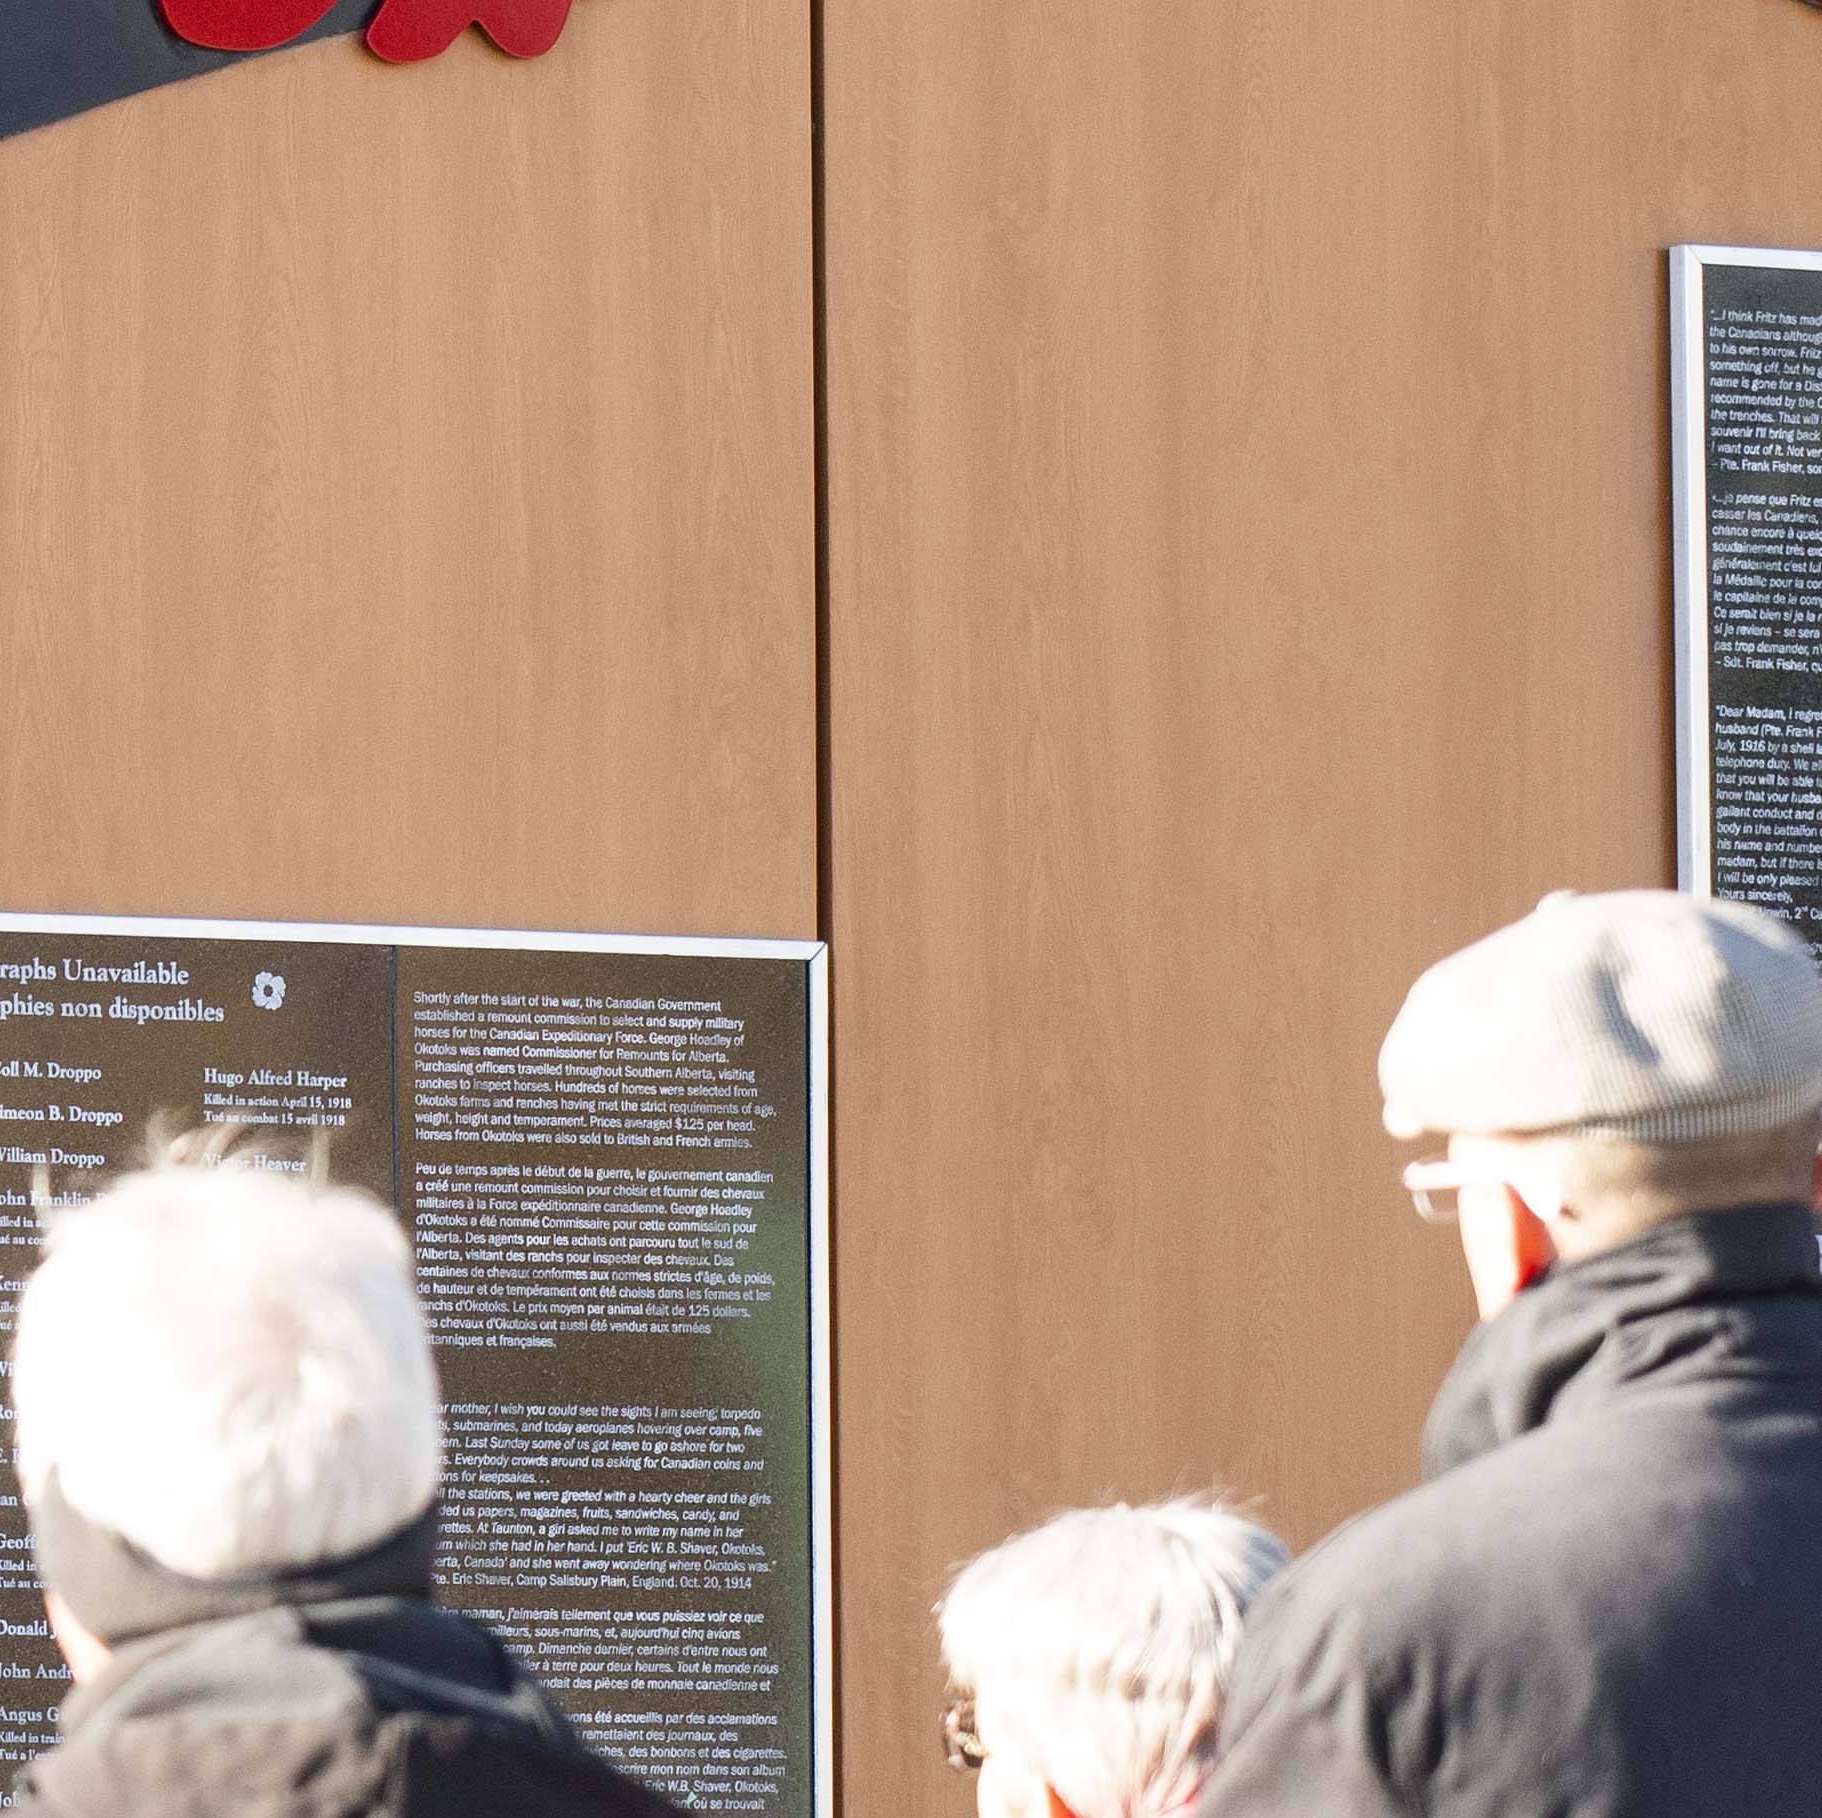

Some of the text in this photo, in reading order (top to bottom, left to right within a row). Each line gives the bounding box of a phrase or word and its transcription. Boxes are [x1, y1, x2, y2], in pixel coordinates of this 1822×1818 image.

[62, 958, 189, 984] Unavailable
[60, 1002, 102, 1018] non
[108, 995, 224, 1025] disponibles
[413, 990, 721, 1012] Shortly after the start of the war, the Canadian Government
[23, 1061, 43, 1077] M.
[46, 1062, 101, 1083] Droppo
[204, 1067, 347, 1091] Hugo Alfred Harper
[48, 1104, 64, 1121] B.
[68, 1105, 123, 1126] Droppo
[50, 1148, 104, 1169] Droppo
